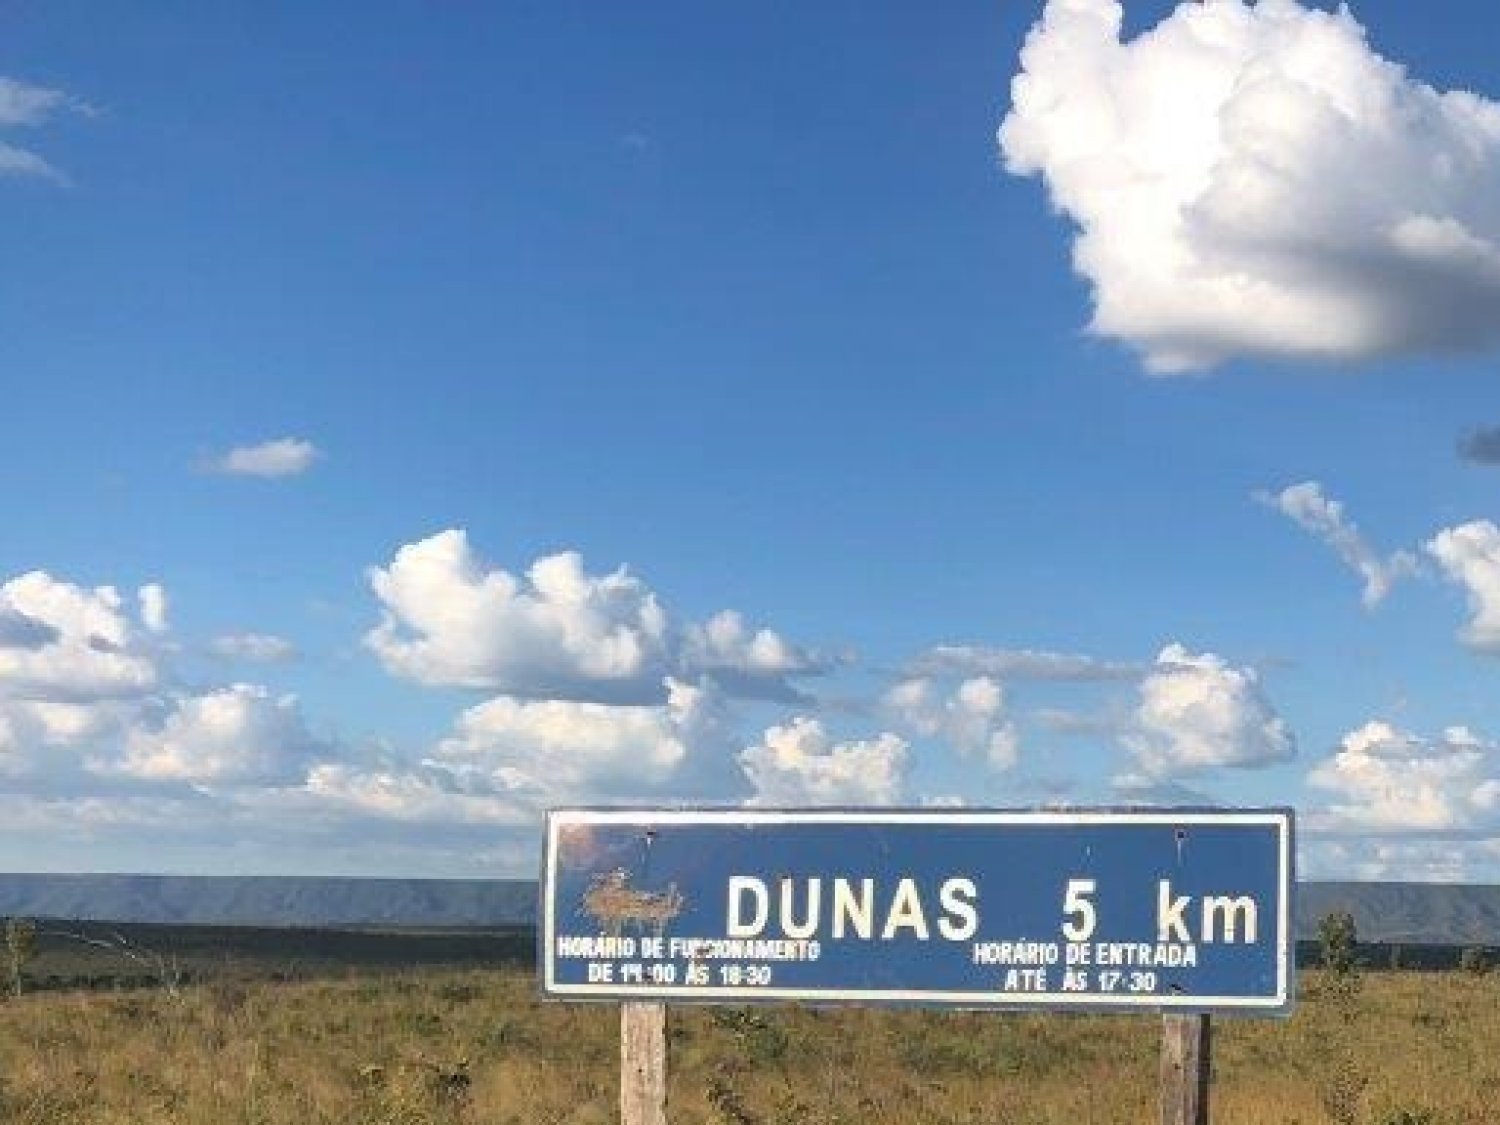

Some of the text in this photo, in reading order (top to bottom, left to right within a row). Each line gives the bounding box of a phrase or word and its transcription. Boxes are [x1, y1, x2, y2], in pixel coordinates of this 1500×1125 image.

[727, 875, 1258, 944] DUNAS 5 km
[641, 937, 667, 960] DE
[973, 936, 1197, 967] HORÁRIO DE ENTRADA
[588, 963, 613, 983] DE
[1004, 967, 1047, 991] ATÉ
